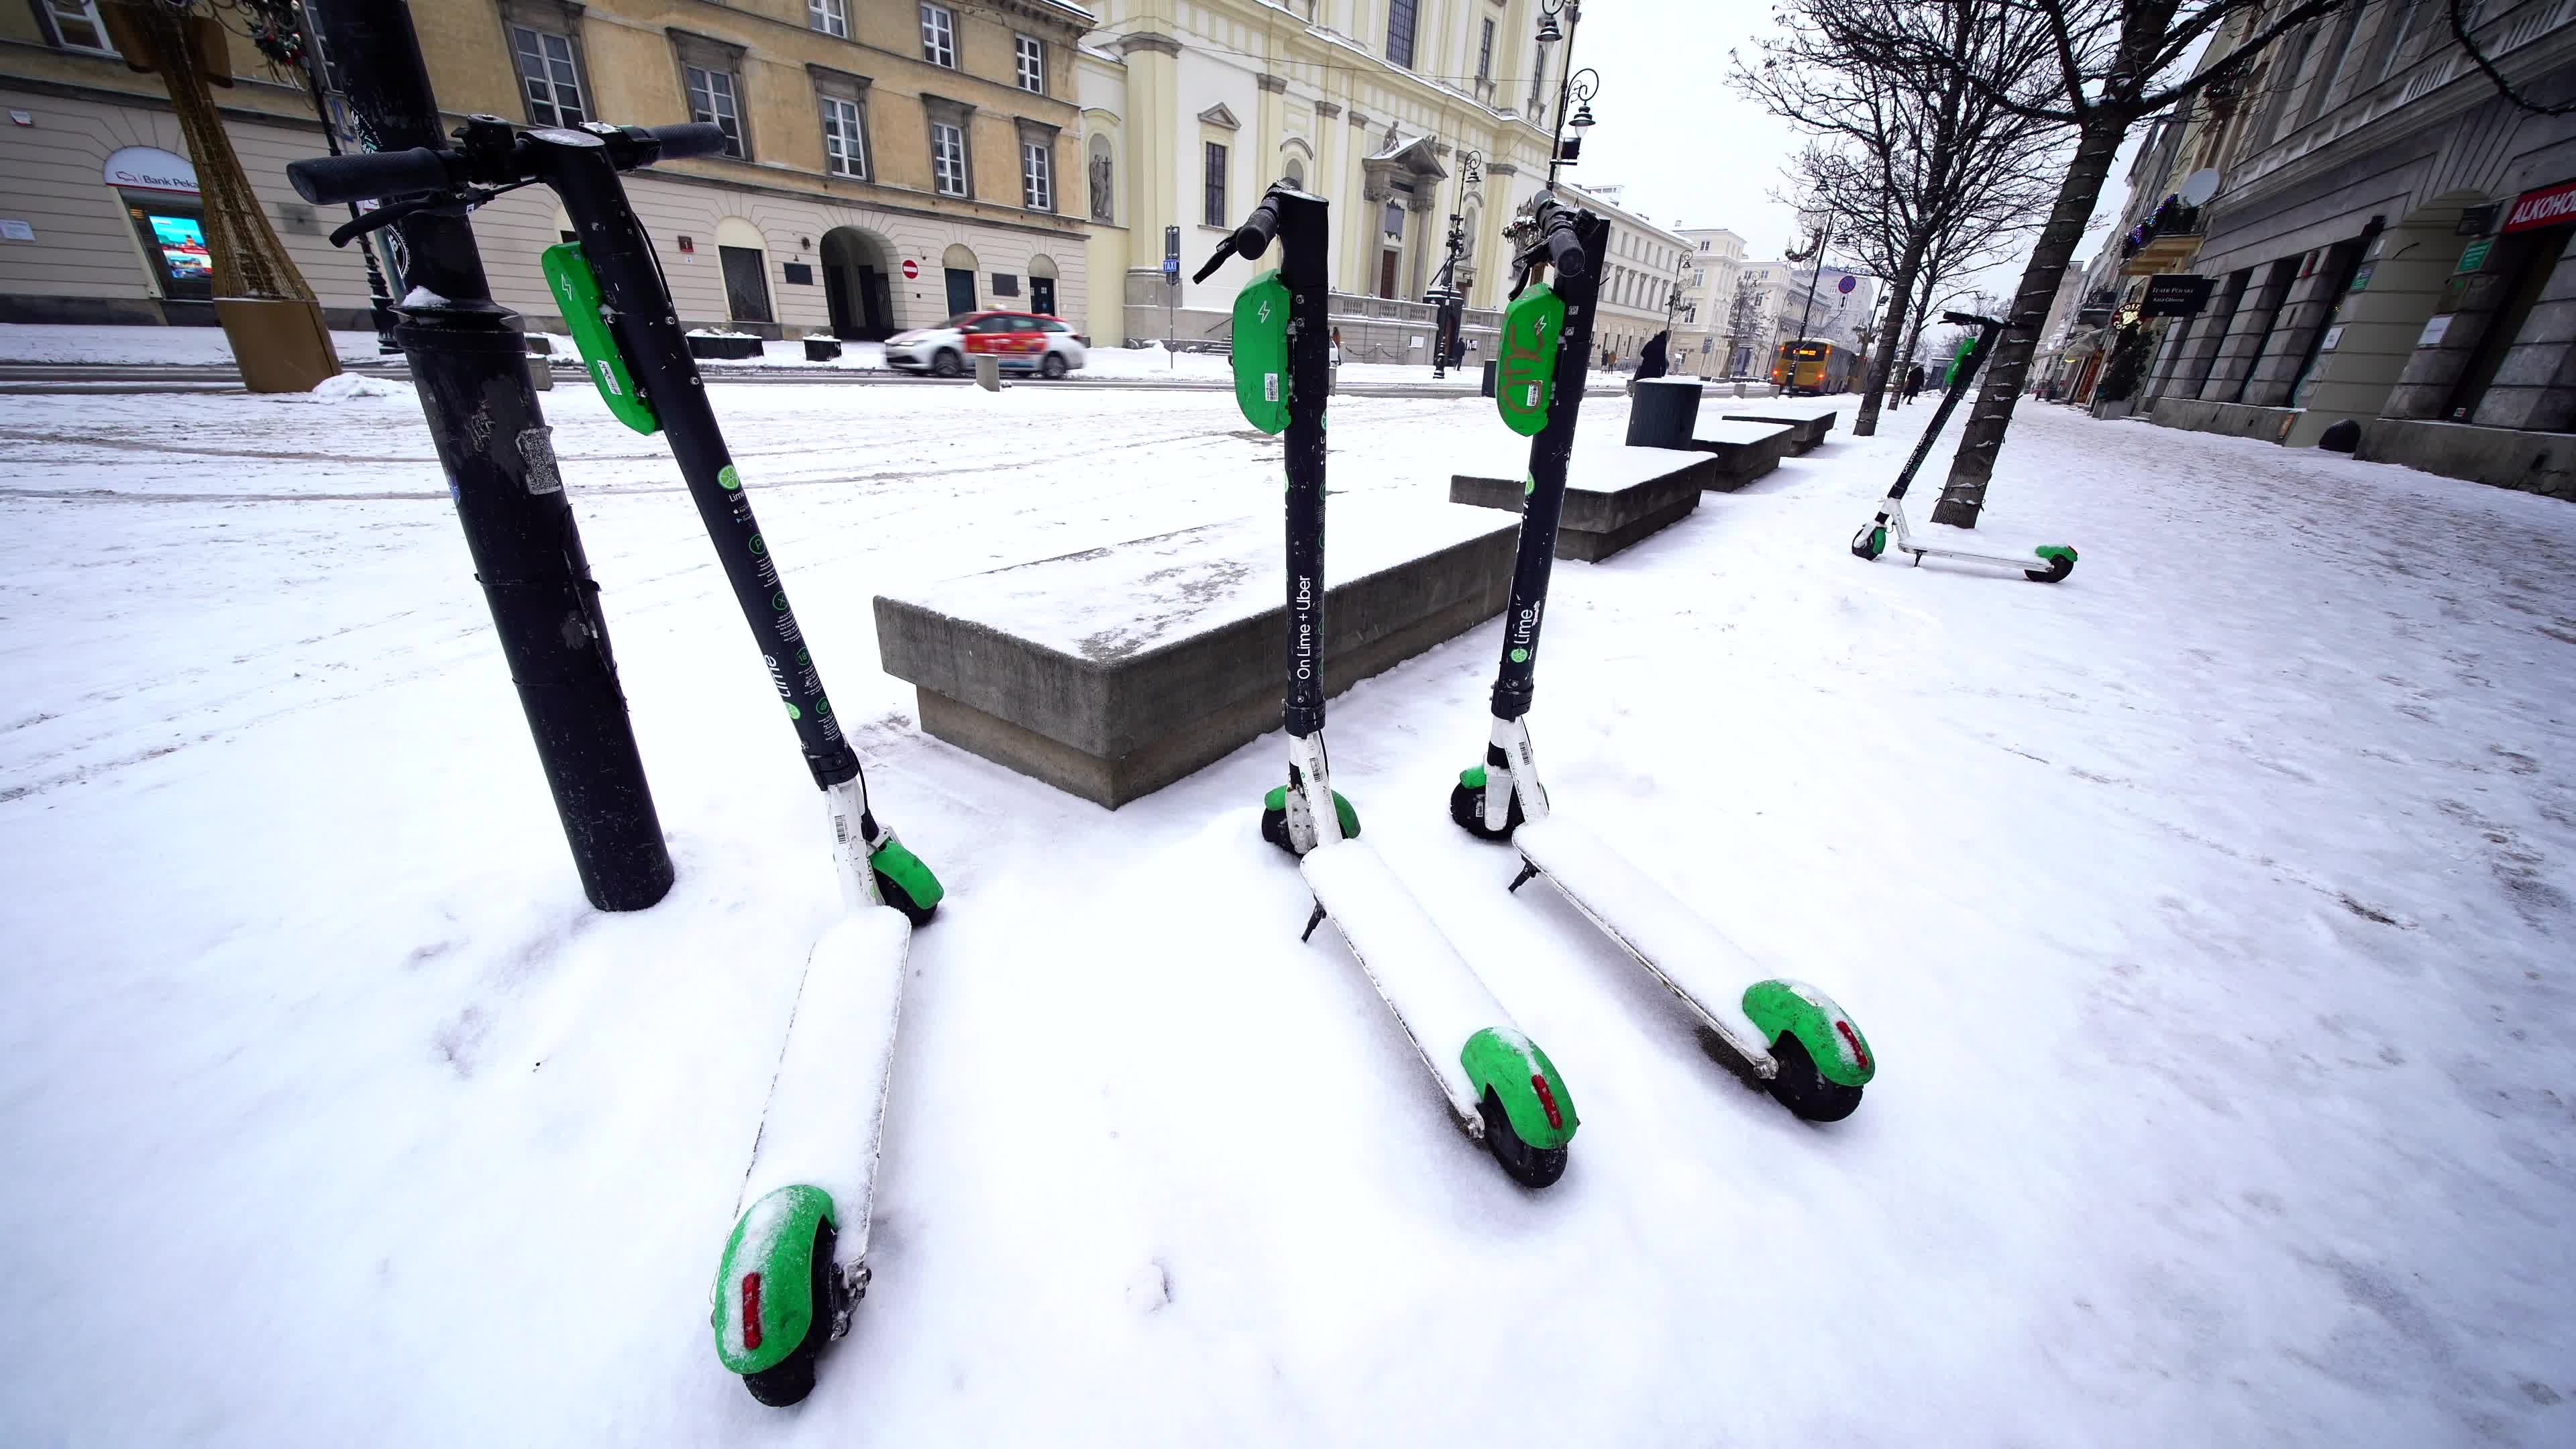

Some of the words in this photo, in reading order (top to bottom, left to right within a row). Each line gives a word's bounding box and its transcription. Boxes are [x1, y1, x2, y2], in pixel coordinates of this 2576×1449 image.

[143, 175, 172, 186] Bank
[172, 178, 199, 188] Peka
[1164, 261, 1177, 271] TAXI
[1296, 575, 1311, 610] Uber
[1297, 624, 1311, 657] Lime
[1513, 609, 1534, 644] Lime
[764, 654, 792, 698] Lime
[1297, 659, 1311, 680] On
